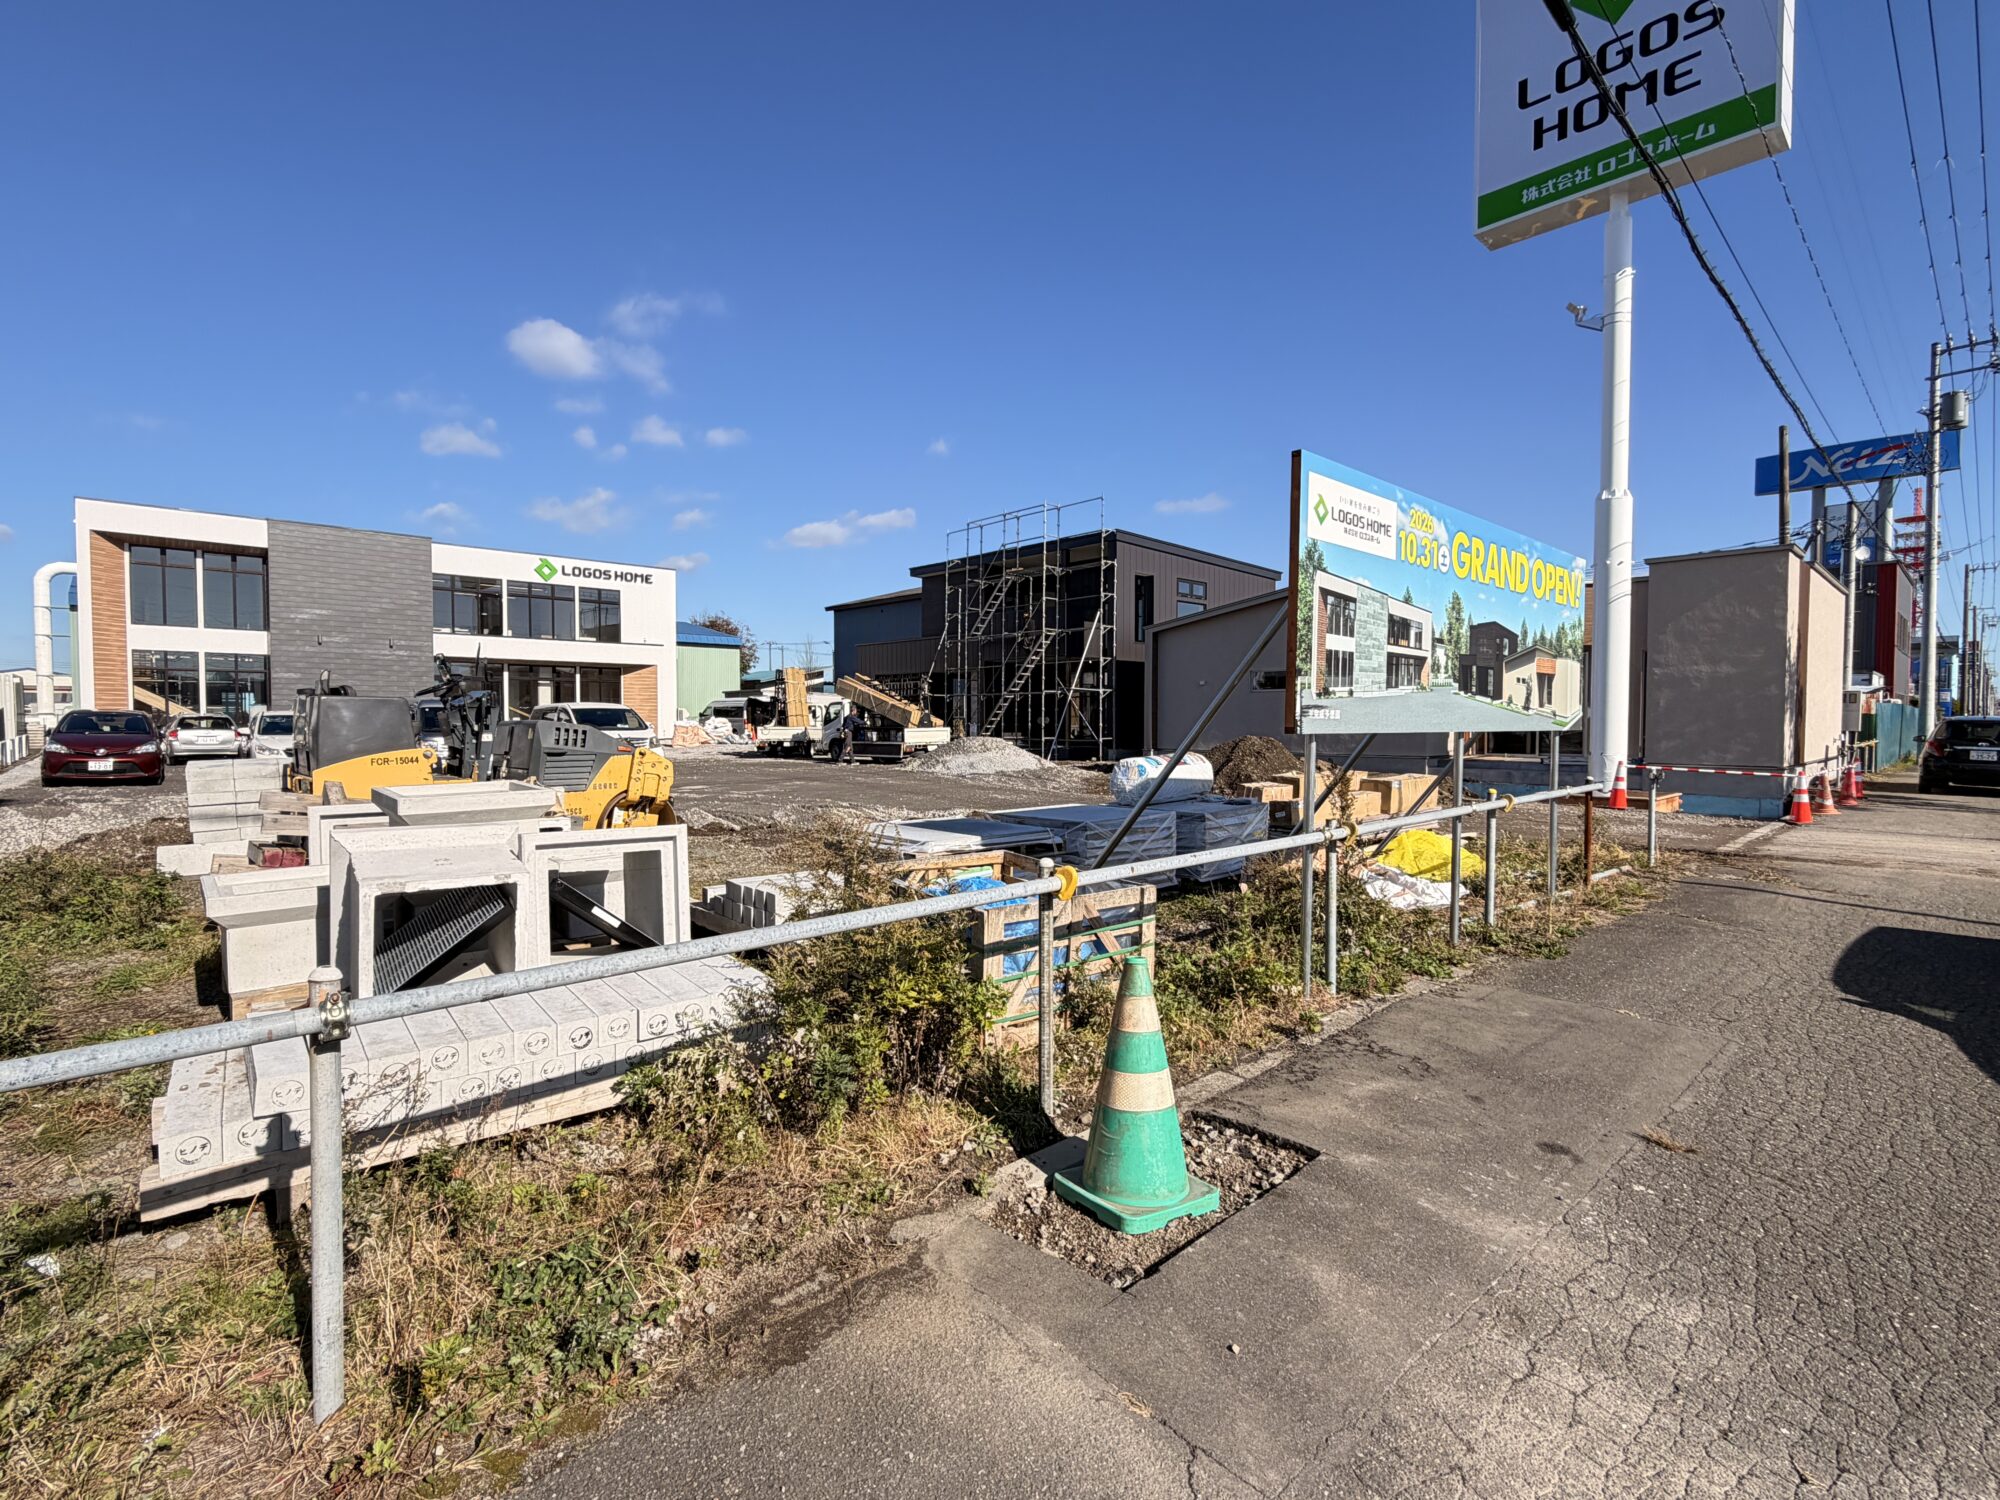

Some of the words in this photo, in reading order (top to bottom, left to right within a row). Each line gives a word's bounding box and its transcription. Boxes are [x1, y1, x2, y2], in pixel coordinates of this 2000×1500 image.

[1518, 0, 1725, 109] LOGOS
[1533, 50, 1702, 151] HOME
[1521, 166, 1592, 204] 株式会社
[1331, 506, 1365, 529] LOGOS
[1366, 517, 1392, 538] HOME
[1399, 530, 1438, 570] 10.31
[1452, 531, 1530, 594] GRAND
[1532, 558, 1583, 608] OPEN!
[561, 565, 612, 581] LOGOS
[614, 570, 653, 584] HOME
[370, 756, 419, 766] FCR-15044
